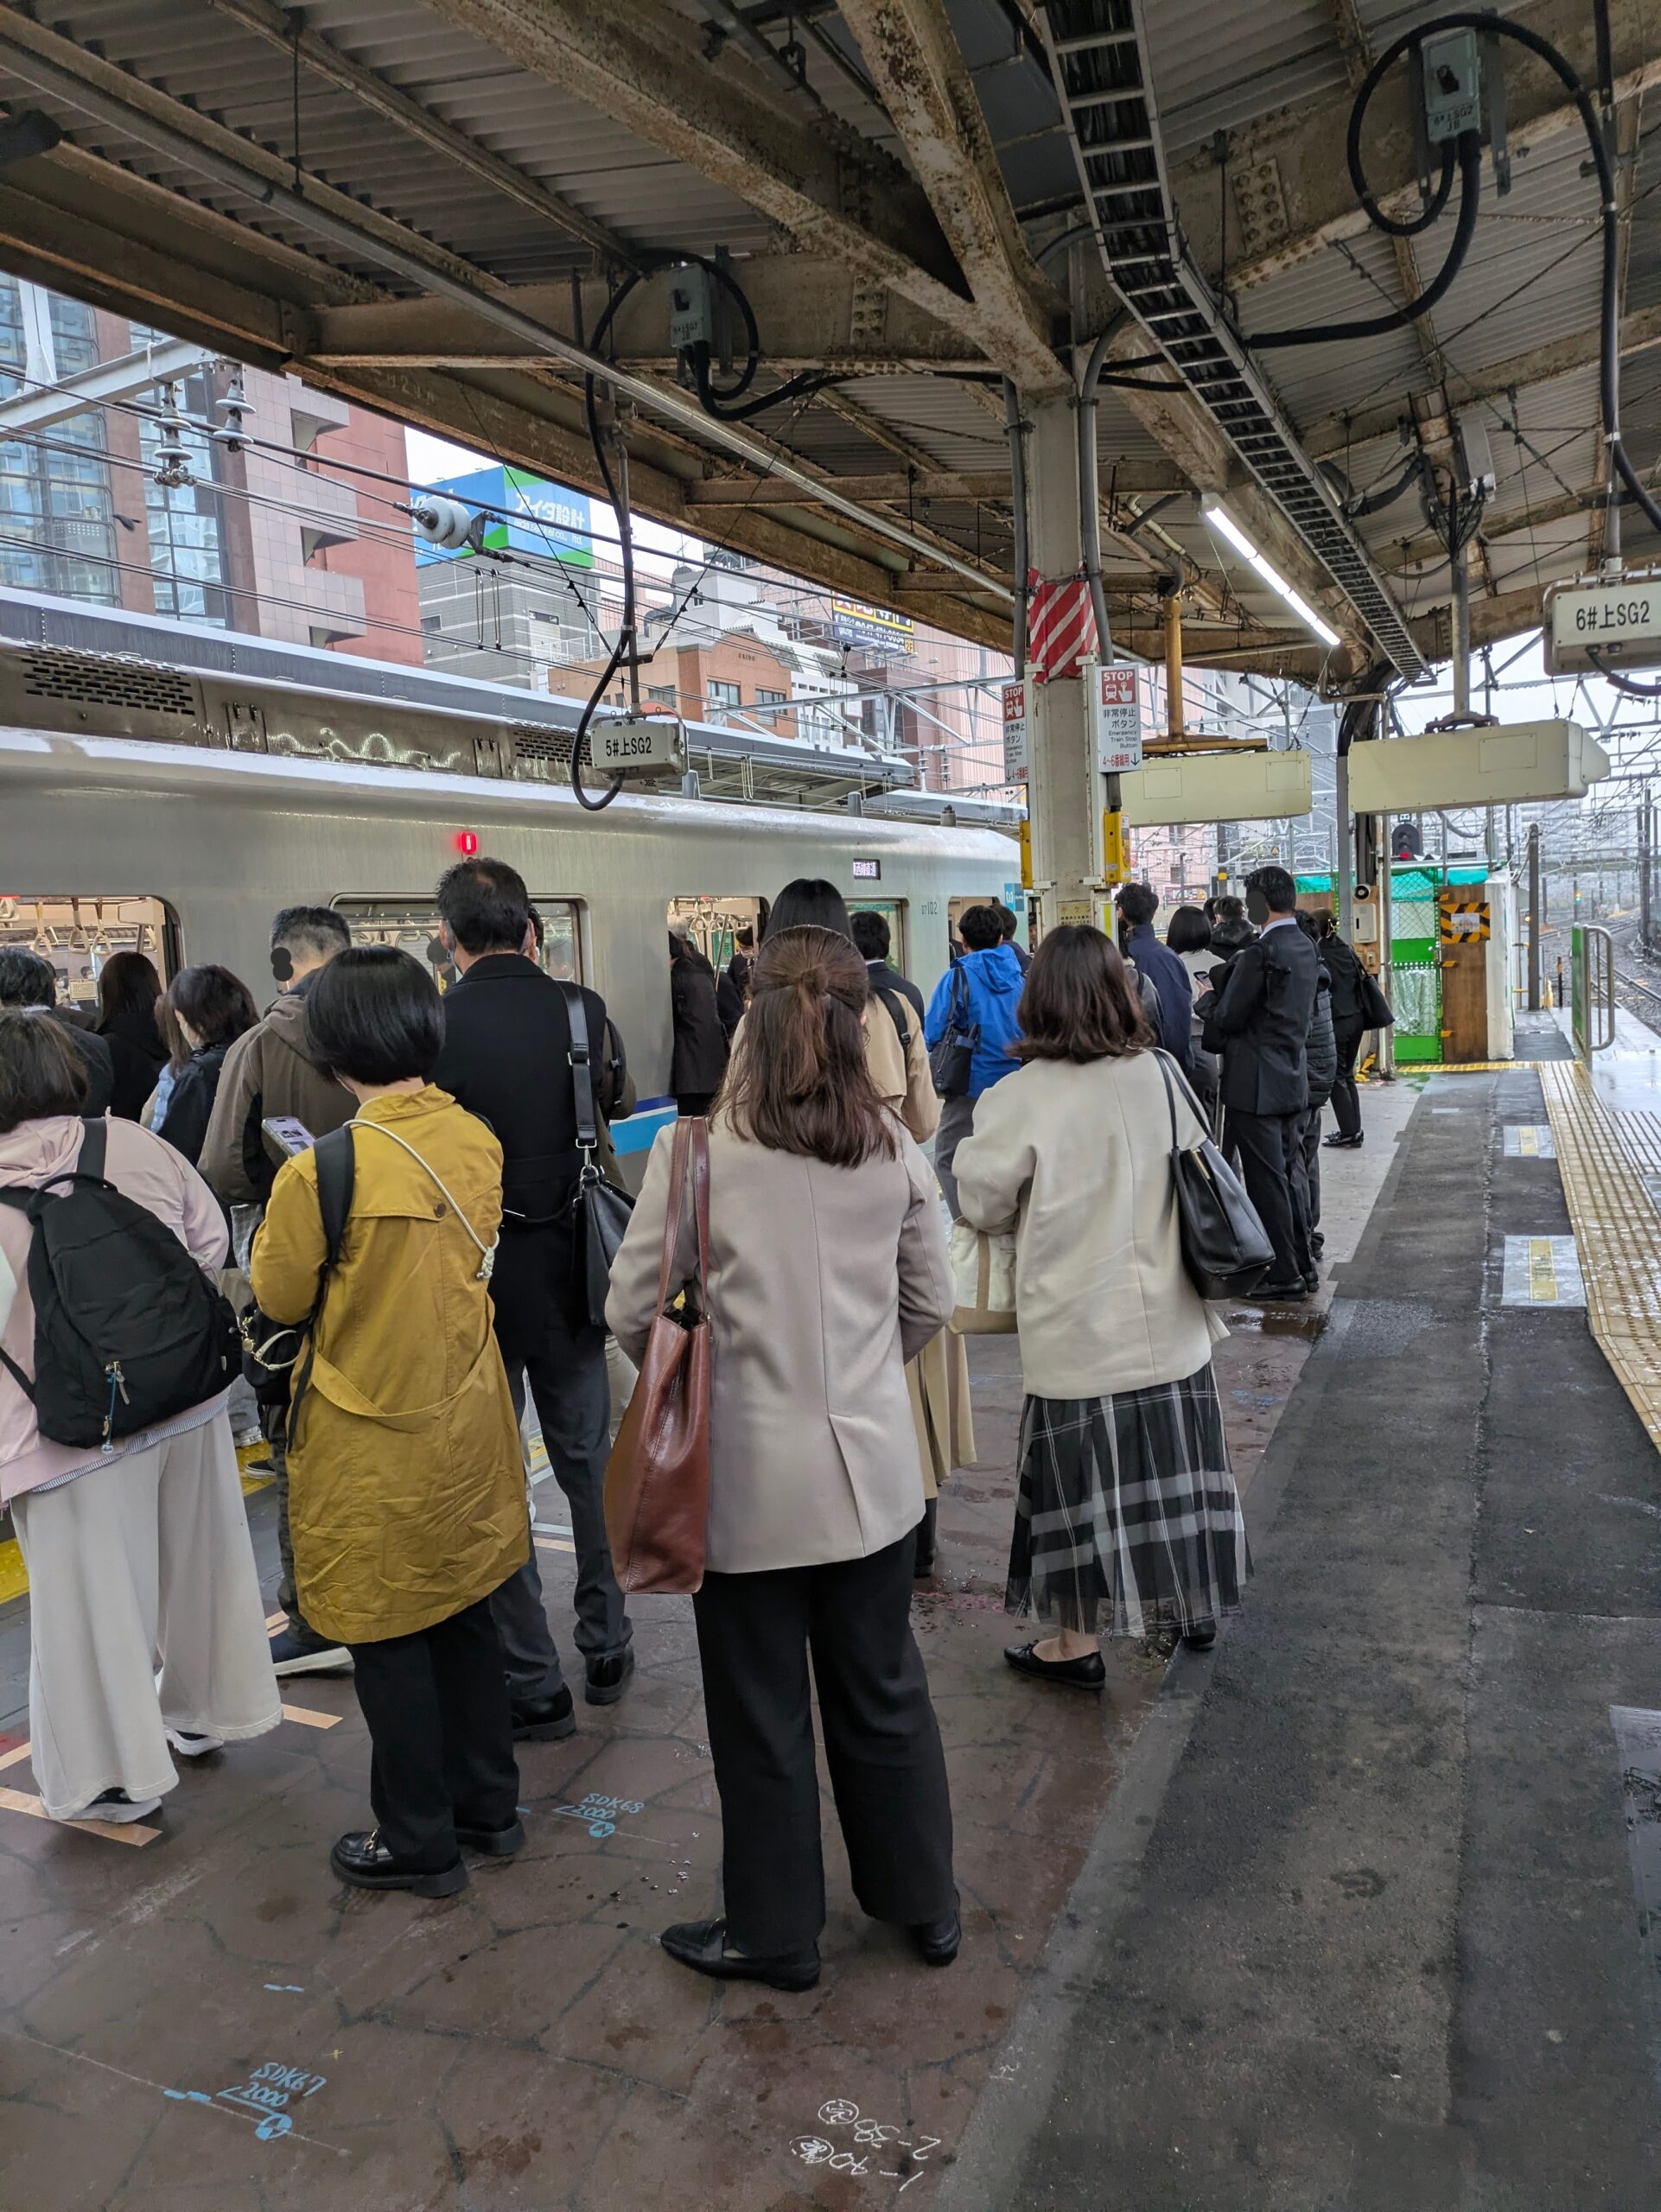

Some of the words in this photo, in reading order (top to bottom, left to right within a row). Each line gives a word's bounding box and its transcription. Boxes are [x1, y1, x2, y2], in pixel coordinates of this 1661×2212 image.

[515, 492, 585, 530] アイダ設計
[1576, 600, 1650, 631] 6#上SG2
[1104, 671, 1133, 682] STOP
[1004, 687, 1023, 699] STOP
[1103, 709, 1136, 718] 非常停止
[1111, 720, 1136, 728] ボタン
[606, 736, 652, 757] 5#上SG2
[582, 1793, 644, 1814] SDK68
[249, 2062, 328, 2097] SDK67
[240, 2082, 290, 2107] 2000
